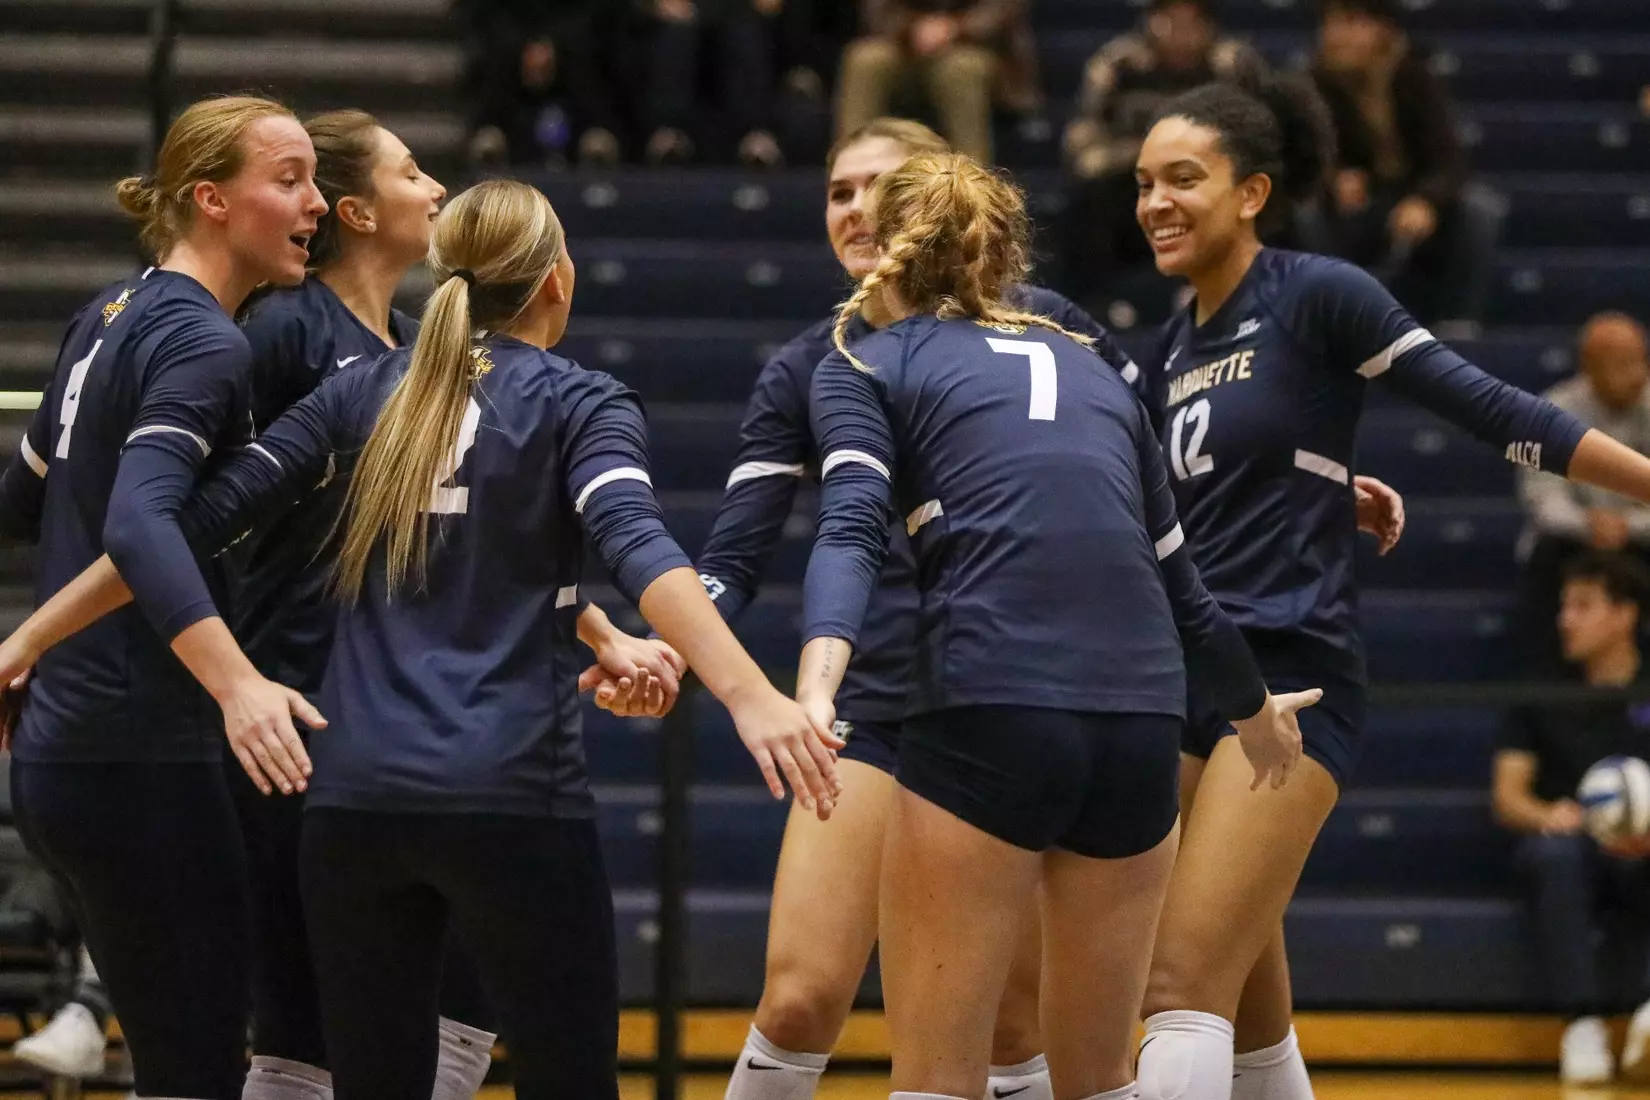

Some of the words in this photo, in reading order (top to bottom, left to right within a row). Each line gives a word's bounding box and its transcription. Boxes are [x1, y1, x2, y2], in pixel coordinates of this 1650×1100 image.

[55, 339, 103, 460] 4
[984, 337, 1057, 421] 7
[1170, 398, 1214, 482] 12
